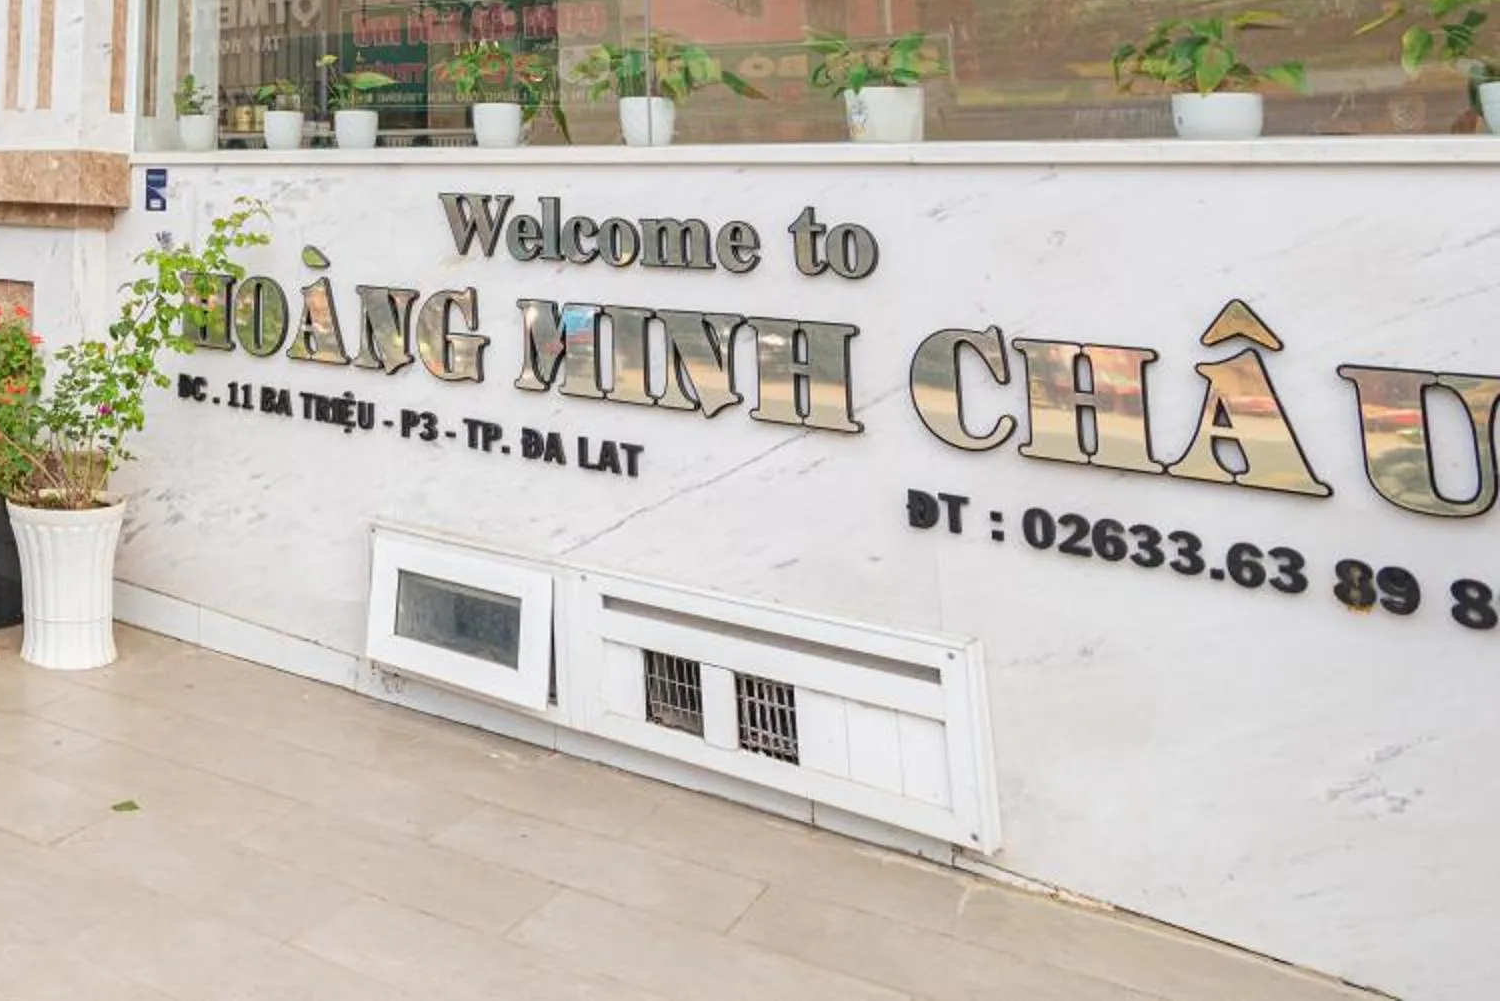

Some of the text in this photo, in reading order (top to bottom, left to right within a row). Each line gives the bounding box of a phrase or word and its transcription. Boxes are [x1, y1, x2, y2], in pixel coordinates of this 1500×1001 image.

[438, 192, 880, 280] Welcome to
[227, 381, 254, 410] 11
[299, 390, 375, 434] TRIỆU
[401, 409, 438, 441] P3
[577, 436, 645, 477] LAT
[515, 298, 865, 434] MINH
[908, 298, 1500, 518] CHÂU
[1021, 507, 1309, 594] 02633.63
[1333, 558, 1422, 616] 89
